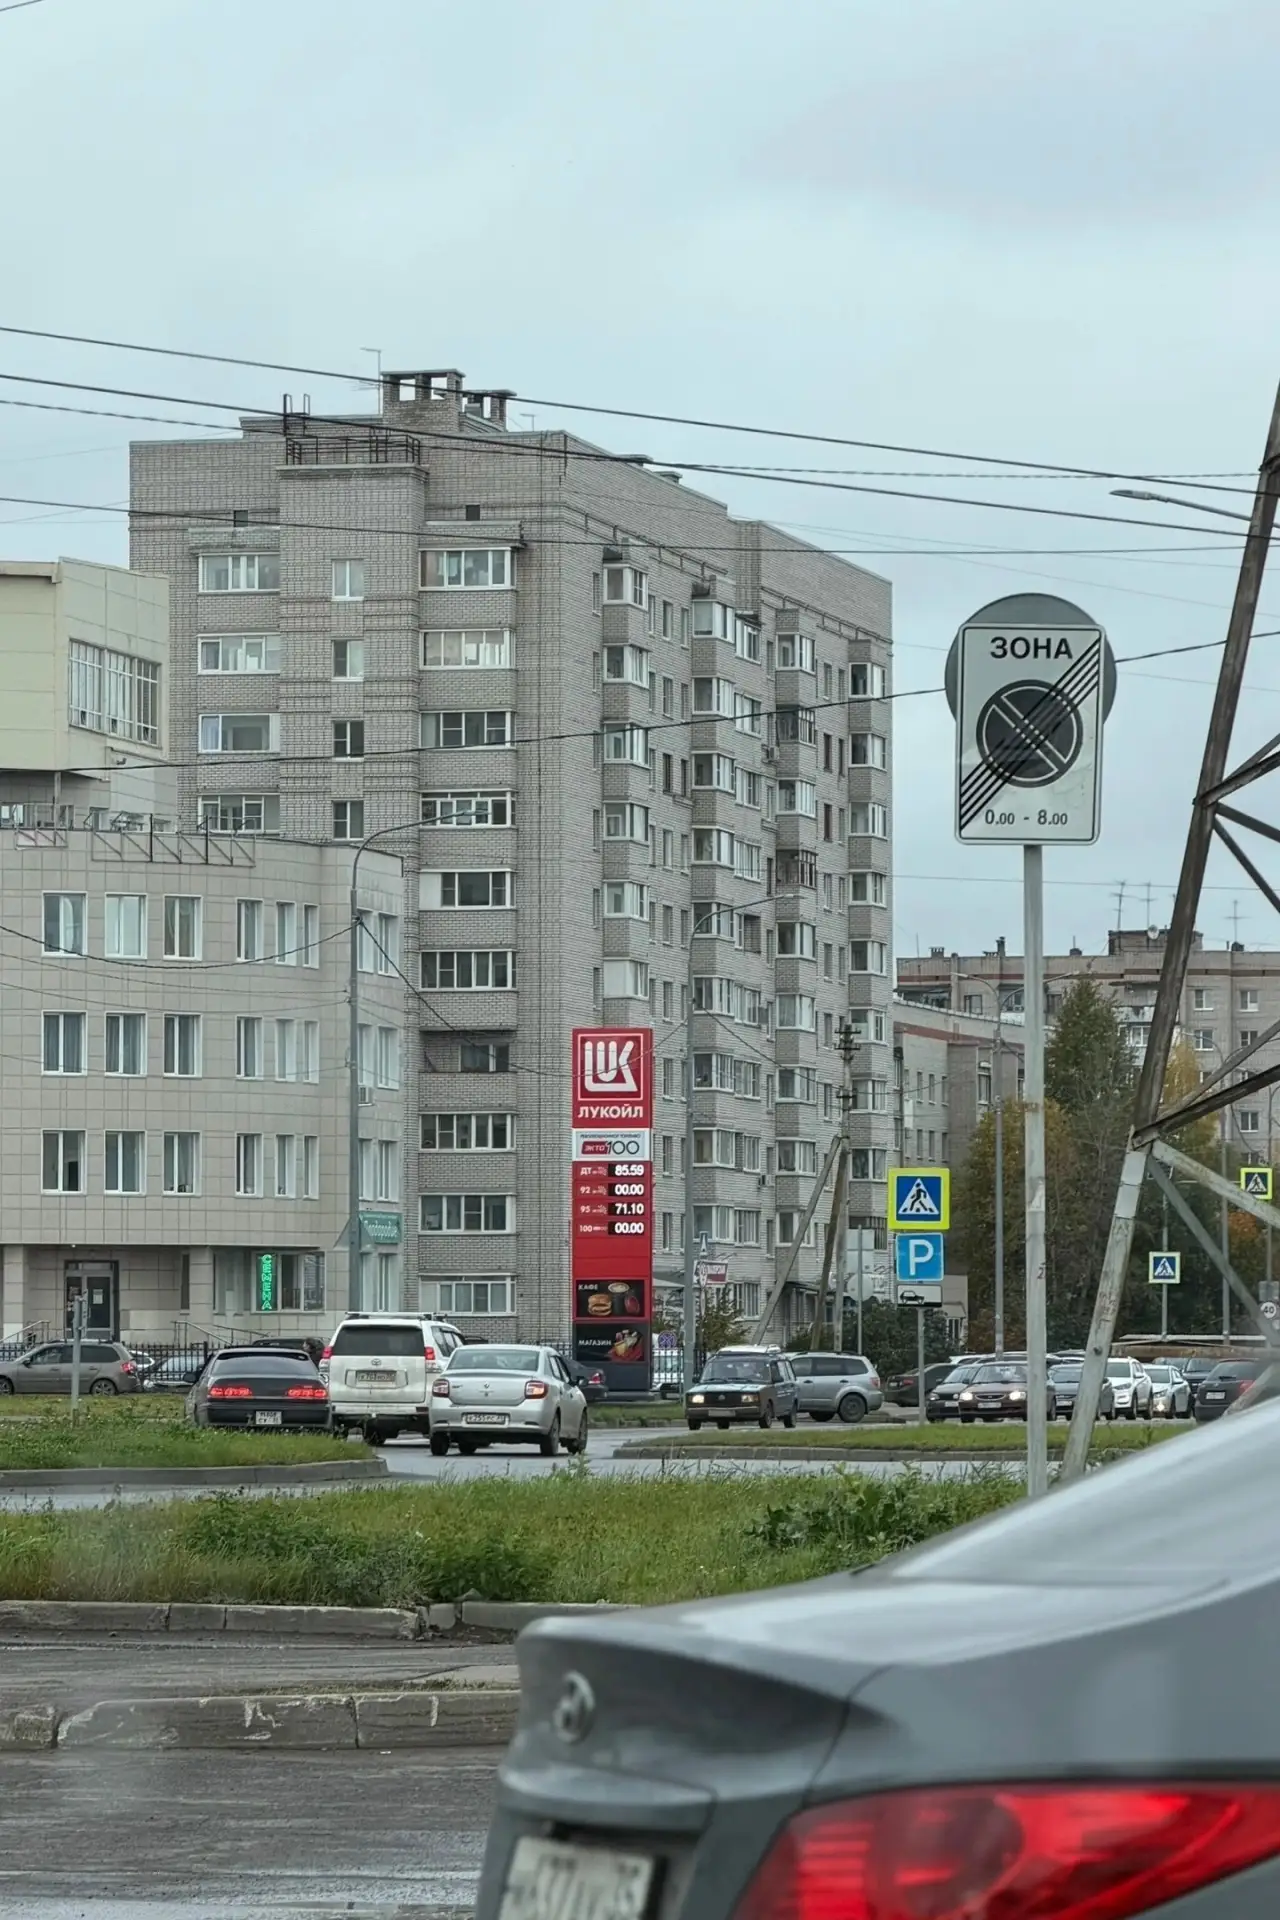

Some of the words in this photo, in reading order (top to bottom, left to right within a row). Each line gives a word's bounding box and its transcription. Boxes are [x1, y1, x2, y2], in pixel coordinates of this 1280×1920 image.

[990, 636, 1073, 659] ЗОНА
[985, 809, 1015, 825] 0.00
[1037, 809, 1068, 825] 8.00
[578, 1103, 643, 1118] ЛУКОЙЛ
[606, 1140, 640, 1155] 100
[580, 1166, 592, 1175] ДТ
[615, 1164, 645, 1176] 85.59
[580, 1186, 591, 1194] 92
[615, 1184, 645, 1195] 00.00
[580, 1205, 591, 1213] 95
[615, 1203, 645, 1215] 71.10
[579, 1224, 593, 1232] 100
[615, 1222, 645, 1234] 00.00
[909, 1239, 934, 1276] P
[261, 1254, 273, 1310] СЕМЕНА
[1263, 1305, 1275, 1314] 40
